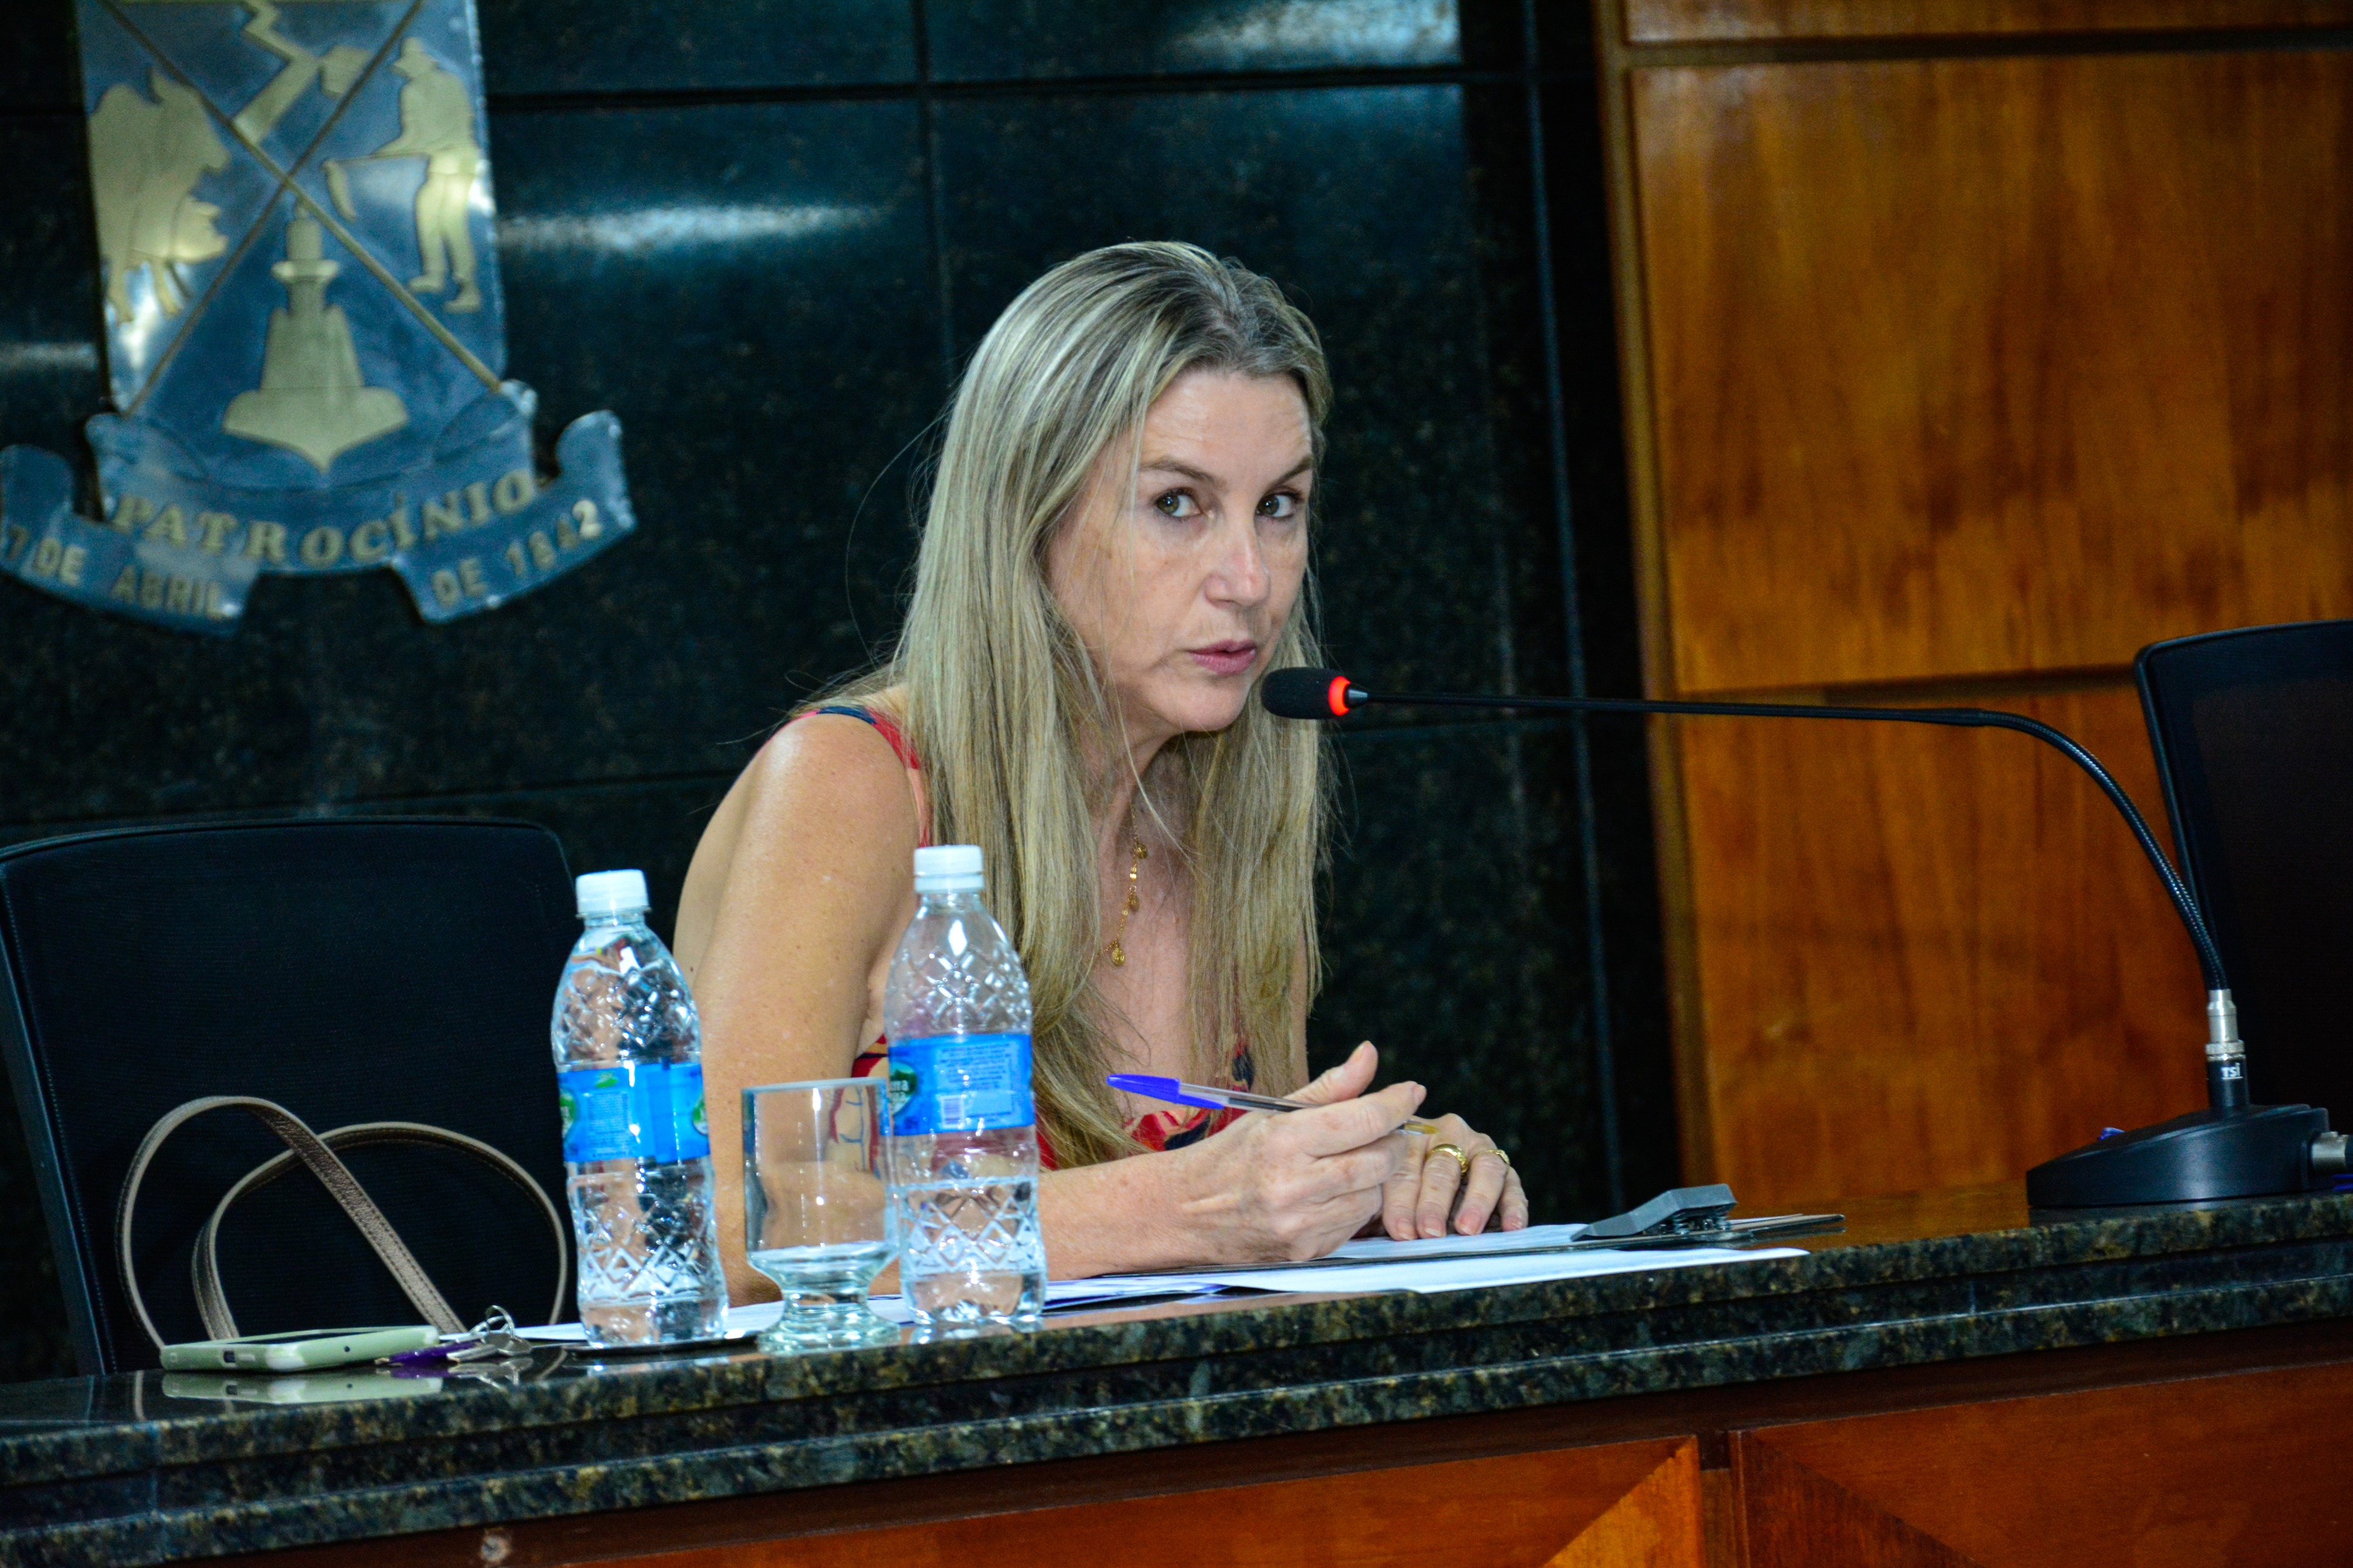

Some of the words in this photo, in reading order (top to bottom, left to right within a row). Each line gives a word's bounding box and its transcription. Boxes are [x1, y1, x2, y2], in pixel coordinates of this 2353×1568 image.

[111, 469, 536, 567] PATROCÍNIO
[32, 537, 87, 587] DE
[111, 565, 225, 621] ABRIL
[432, 558, 487, 607] DE
